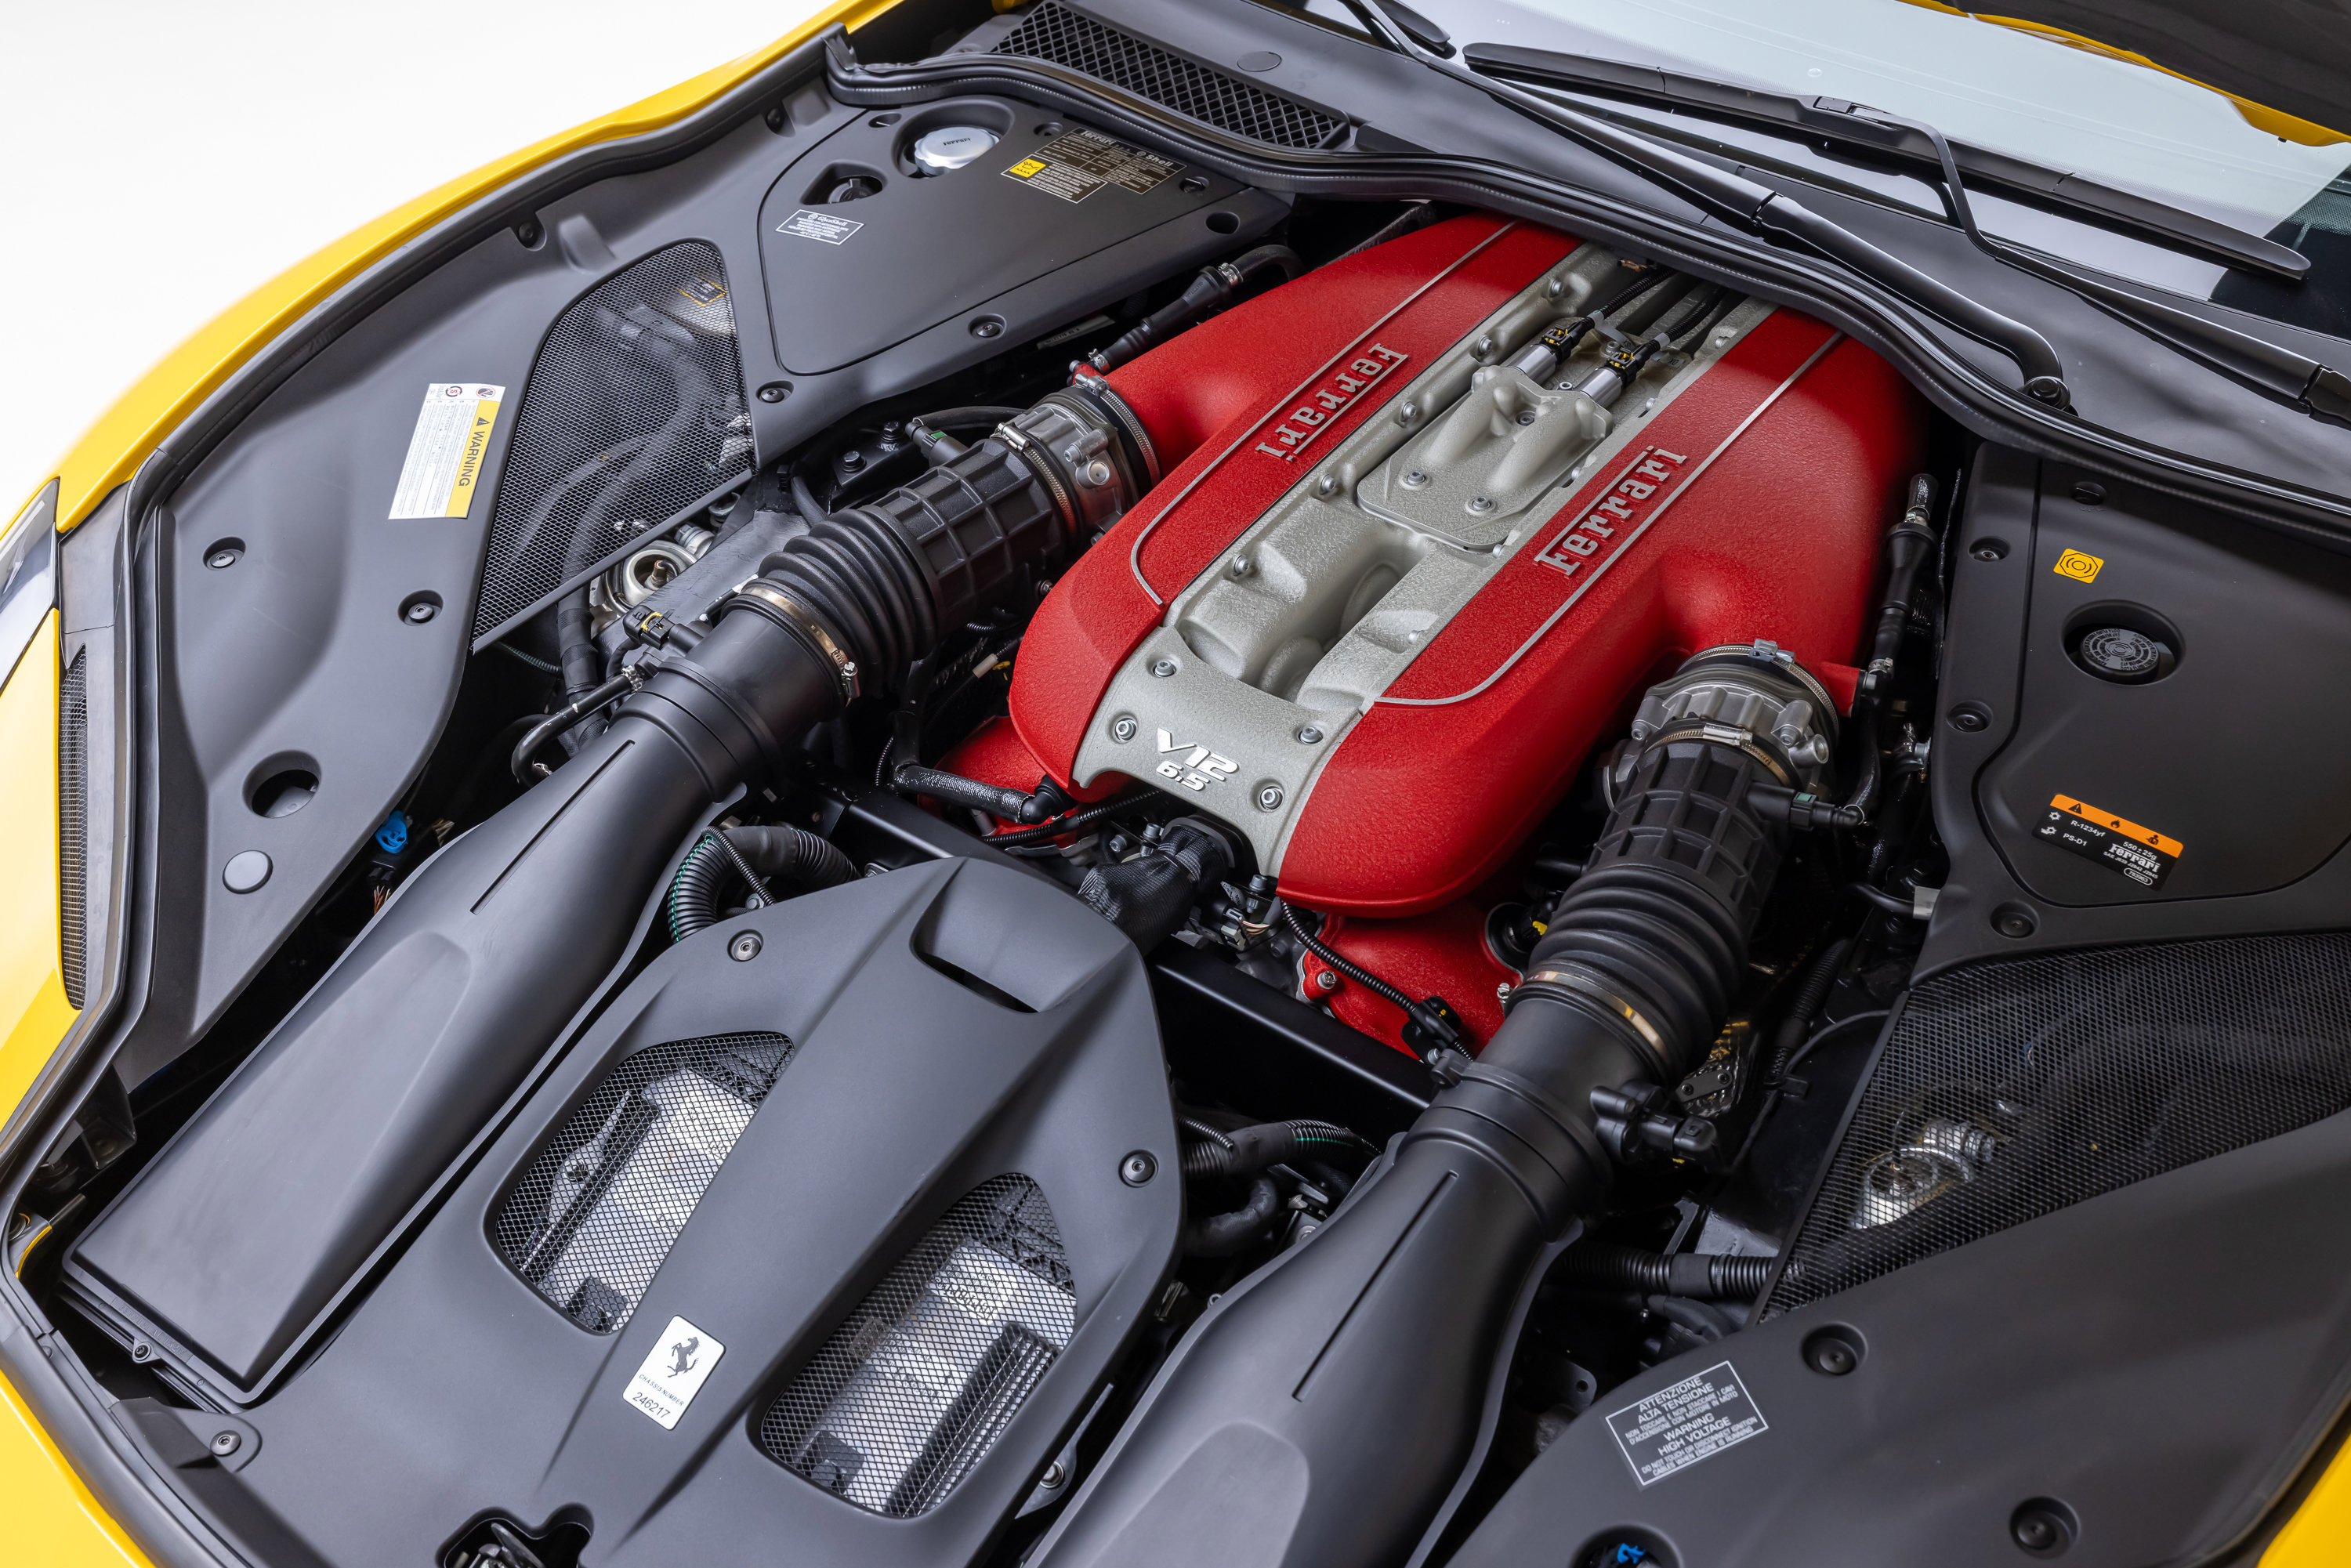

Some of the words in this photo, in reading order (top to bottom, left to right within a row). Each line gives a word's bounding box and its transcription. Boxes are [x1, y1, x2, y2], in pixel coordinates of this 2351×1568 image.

[943, 137, 971, 146] Ferrari
[1081, 130, 1114, 146] Ferrari
[1145, 154, 1174, 168] Shell
[1255, 342, 1408, 462] Ferrari
[458, 431, 485, 487] WARNING
[1534, 445, 1687, 577] Ferrari
[1157, 727, 1240, 781] V12
[1157, 760, 1210, 791] 6.5
[2063, 833, 2087, 846] PS-D1
[2071, 820, 2105, 837] R-1234yf
[2109, 844, 2160, 872] Ferrari
[632, 1392, 671, 1418] 246217
[639, 1374, 663, 1392] CHASSIS
[661, 1389, 684, 1407] NUMBER
[1638, 1408, 1662, 1424] ALTA
[1661, 1383, 1713, 1411] TENSIONE
[1640, 1377, 1702, 1412] ATTENZIONE
[1625, 1429, 1640, 1438] NON
[1672, 1407, 1687, 1417] NON
[1658, 1438, 1685, 1455] HIGH
[1685, 1417, 1731, 1442] VOLTAGE
[1664, 1413, 1714, 1441] WARNING
[1641, 1465, 1652, 1473] DO
[1651, 1459, 1664, 1468] NOT
